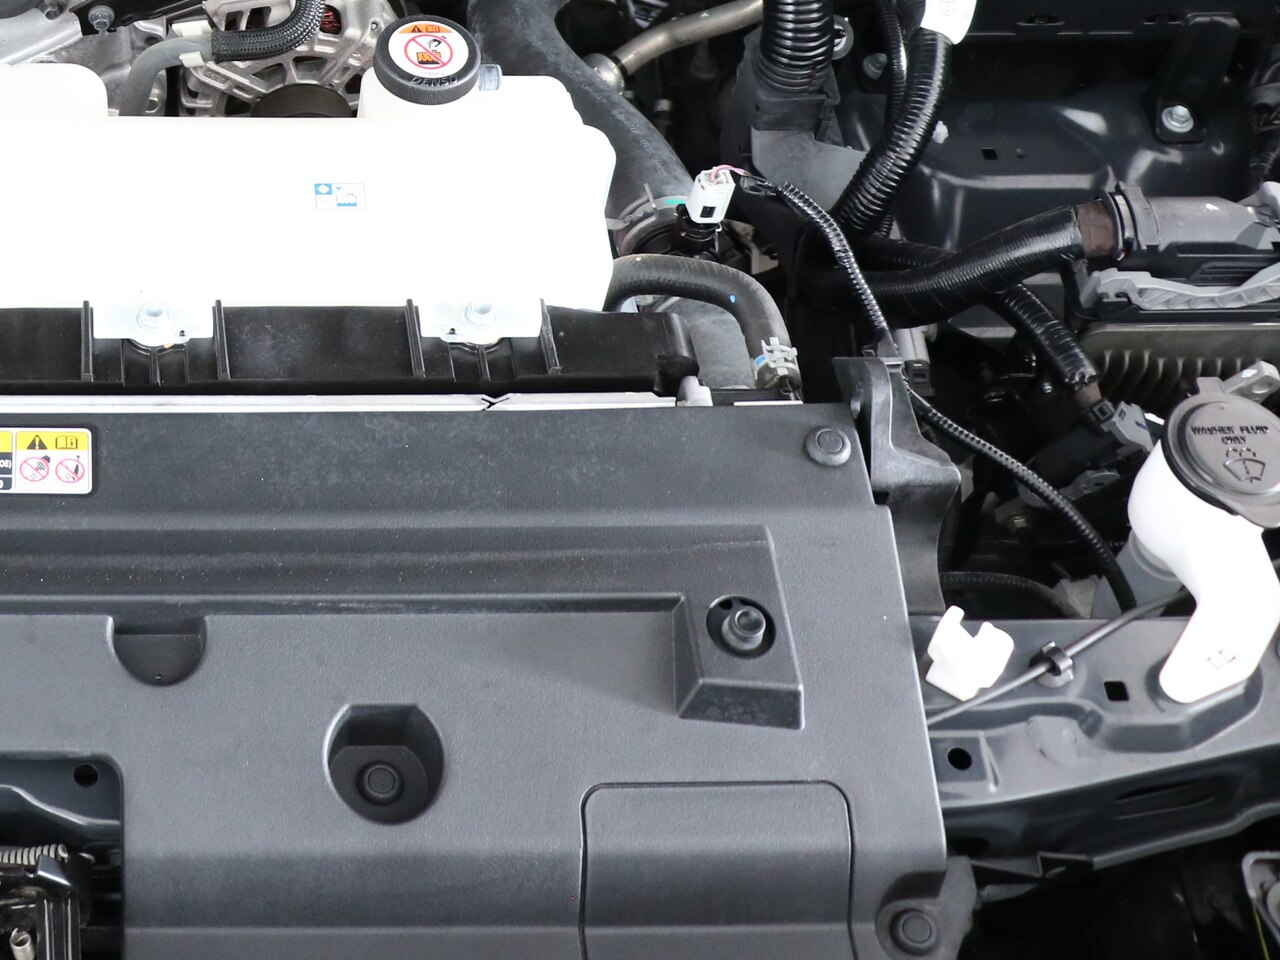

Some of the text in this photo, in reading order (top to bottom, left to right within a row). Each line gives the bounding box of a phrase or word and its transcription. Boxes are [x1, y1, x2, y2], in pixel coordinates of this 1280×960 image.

[410, 75, 458, 87] DENSO
[1191, 425, 1270, 435] WASHER FLUID
[1221, 436, 1247, 445] ONLY
